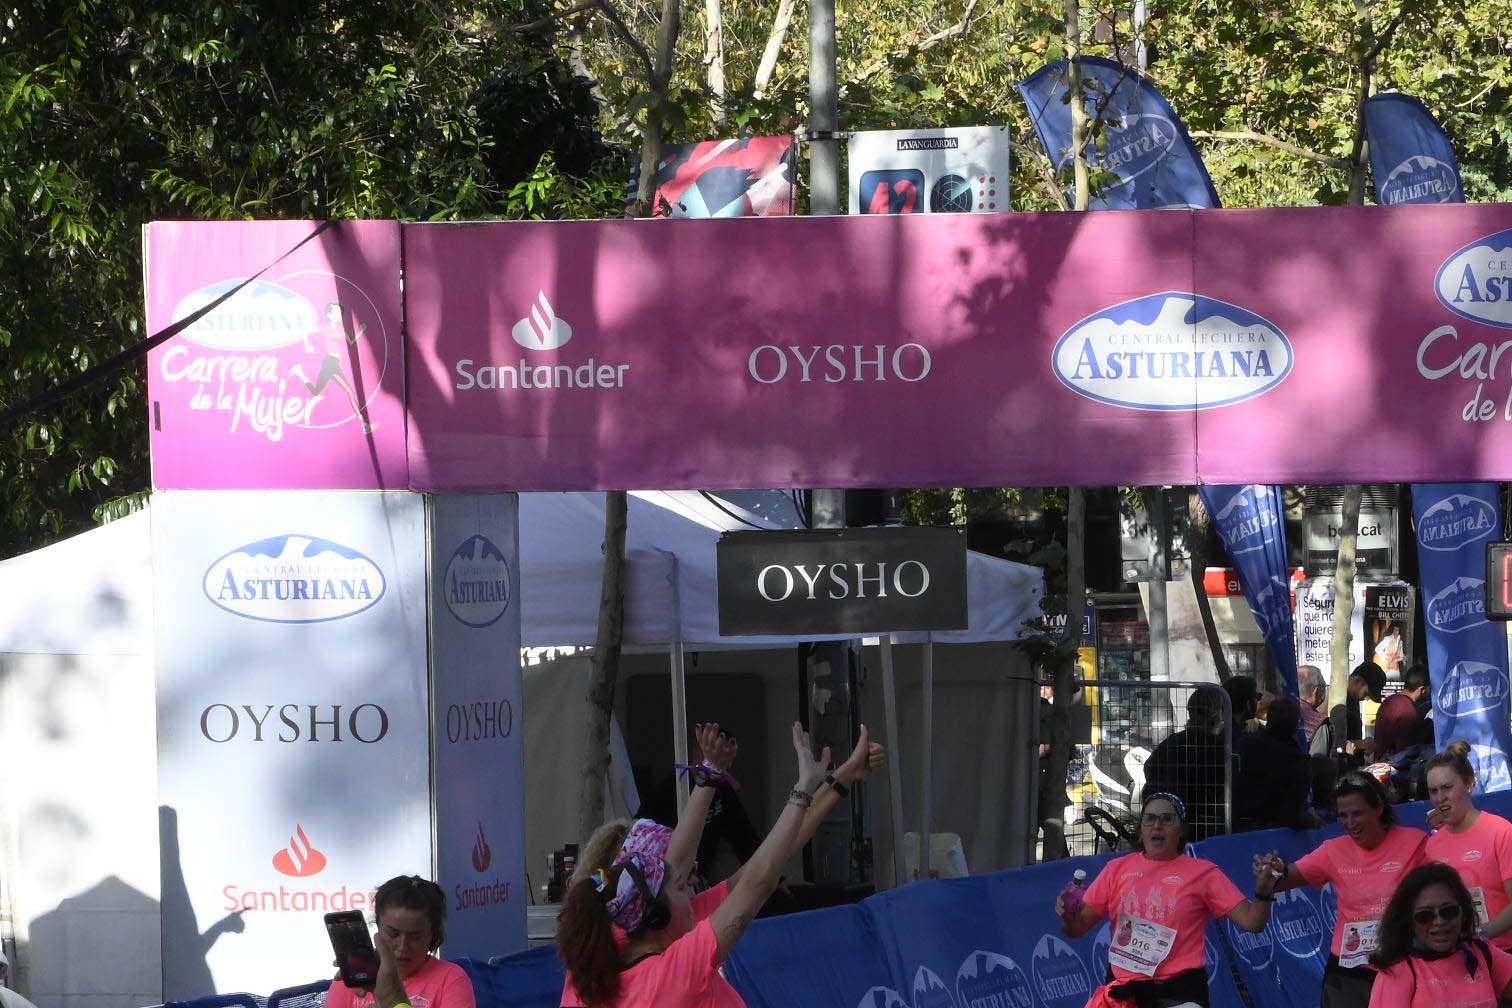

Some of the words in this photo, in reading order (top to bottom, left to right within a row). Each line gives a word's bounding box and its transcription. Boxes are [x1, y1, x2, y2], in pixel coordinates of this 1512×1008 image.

[910, 138, 957, 149] VANGUARDIA
[1108, 333, 1179, 347] CENTRAL
[1189, 331, 1267, 345] LECHERA
[160, 344, 280, 382] Carrera
[456, 359, 630, 390] Santander
[748, 342, 932, 385] OYSHO
[1071, 337, 1274, 381] ASTURIANA
[230, 377, 324, 441] Mujer
[1461, 383, 1497, 422] de
[217, 567, 374, 601] ASTURIANA
[451, 572, 507, 604] ASTURIANA
[757, 559, 931, 602] OYSHO
[1378, 595, 1409, 608] ELVIS
[200, 702, 389, 744] OYSHO
[446, 700, 513, 743] OYSHO
[456, 881, 510, 911] Santander
[1131, 938, 1151, 951] 016
